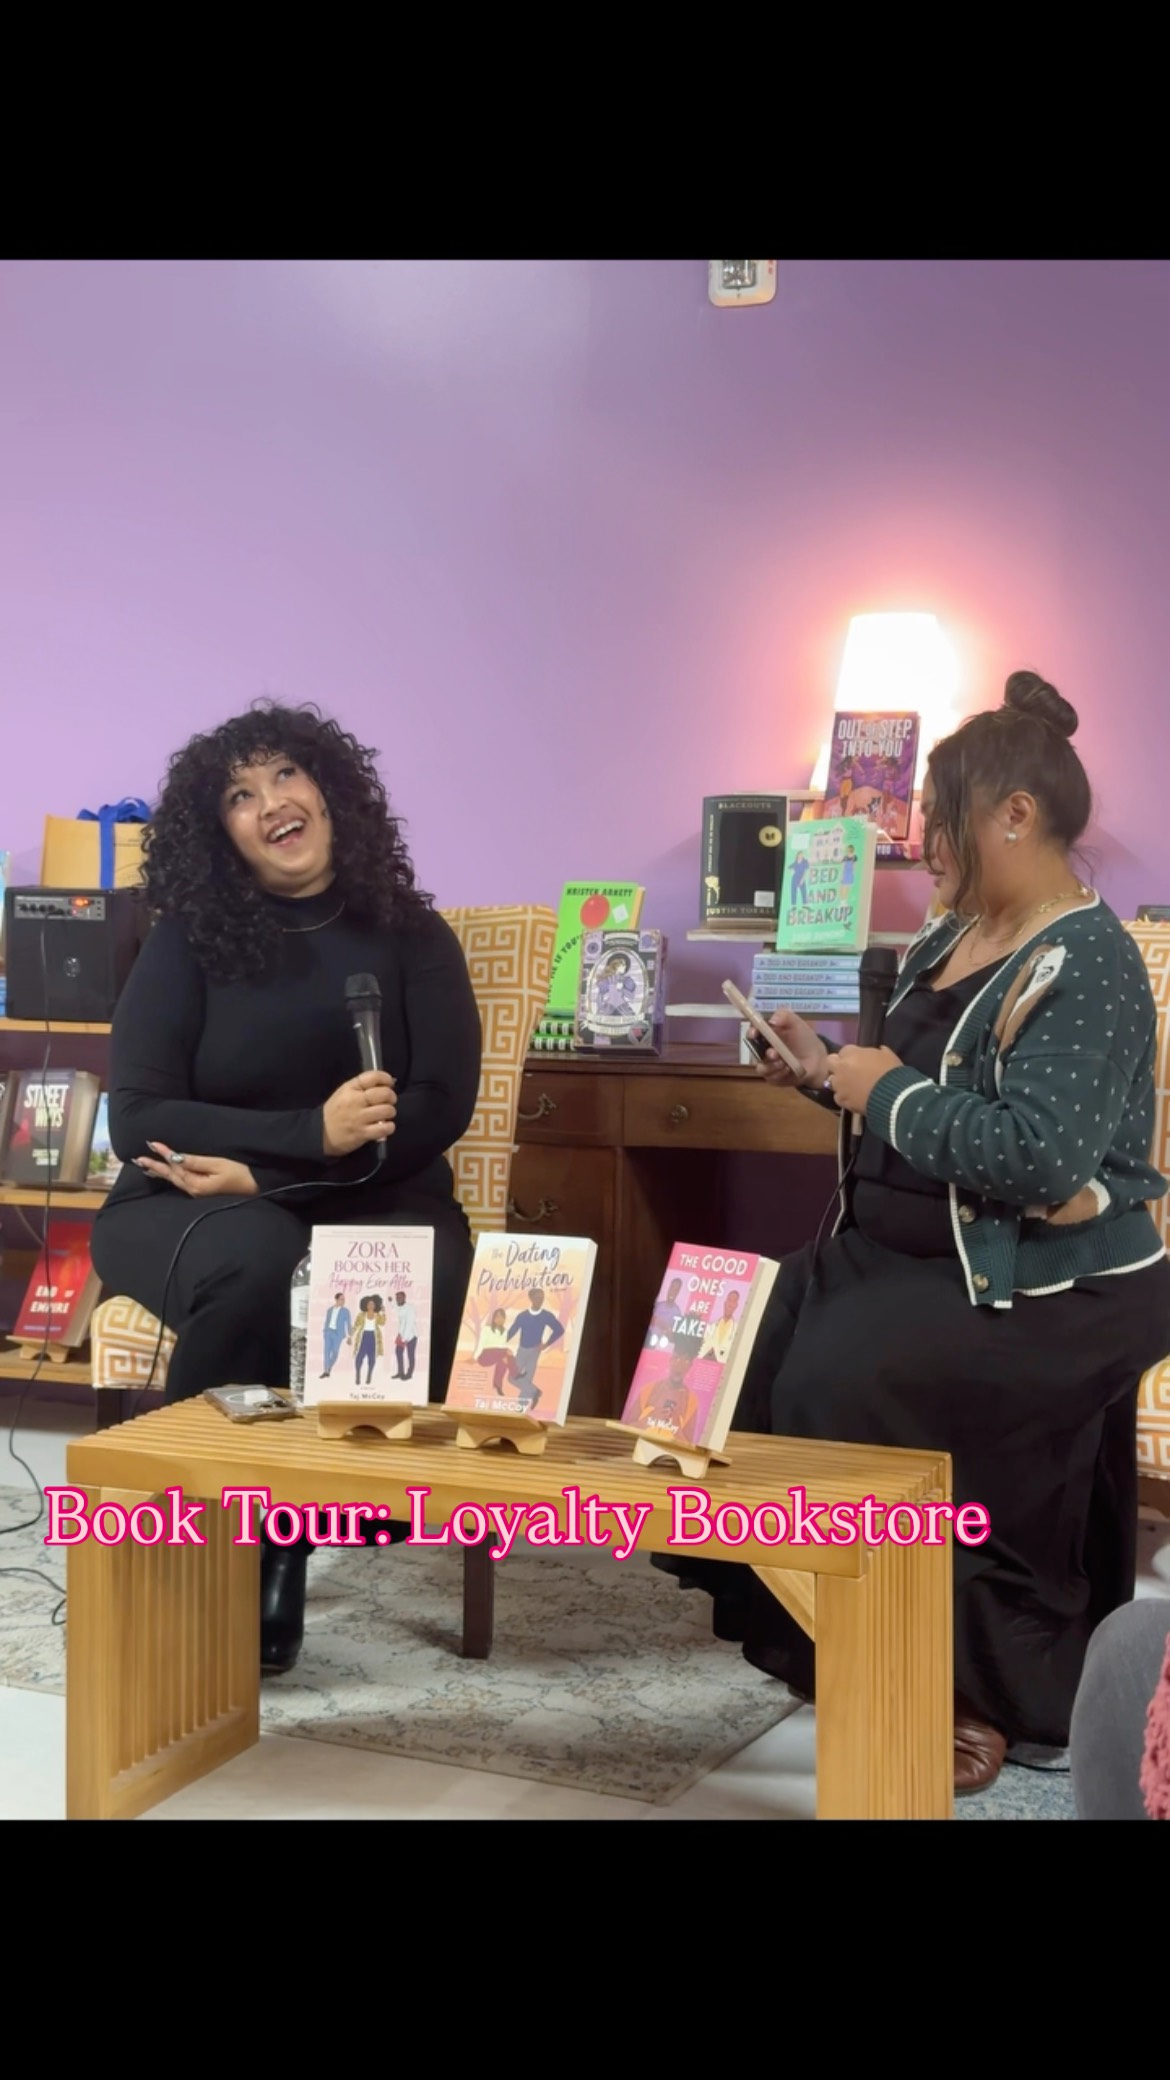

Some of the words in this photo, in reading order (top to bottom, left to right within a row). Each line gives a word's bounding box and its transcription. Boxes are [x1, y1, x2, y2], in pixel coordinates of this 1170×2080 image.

[838, 719, 863, 740] OUT
[880, 719, 912, 740] STEP,
[841, 740, 873, 758] INTO
[878, 740, 903, 758] YOU
[718, 802, 772, 810] BLACKOUTS
[808, 866, 838, 885] BED
[808, 888, 837, 904] AND
[786, 906, 854, 926] BREAKUP
[347, 1241, 399, 1258] ZORA
[505, 1240, 560, 1271] Dating
[334, 1260, 381, 1273] BOOKS
[384, 1260, 412, 1273] HER
[680, 1254, 699, 1268] THE
[701, 1254, 748, 1276] GOOD
[329, 1272, 363, 1294] Happy
[366, 1274, 387, 1289] Ever
[389, 1273, 413, 1288] After
[477, 1266, 574, 1296] Prohibition
[687, 1276, 727, 1296] ONES
[689, 1301, 711, 1314] ARE
[672, 1316, 715, 1338] TAKEN
[475, 1398, 489, 1410] Taj
[491, 1398, 533, 1413] McCoy
